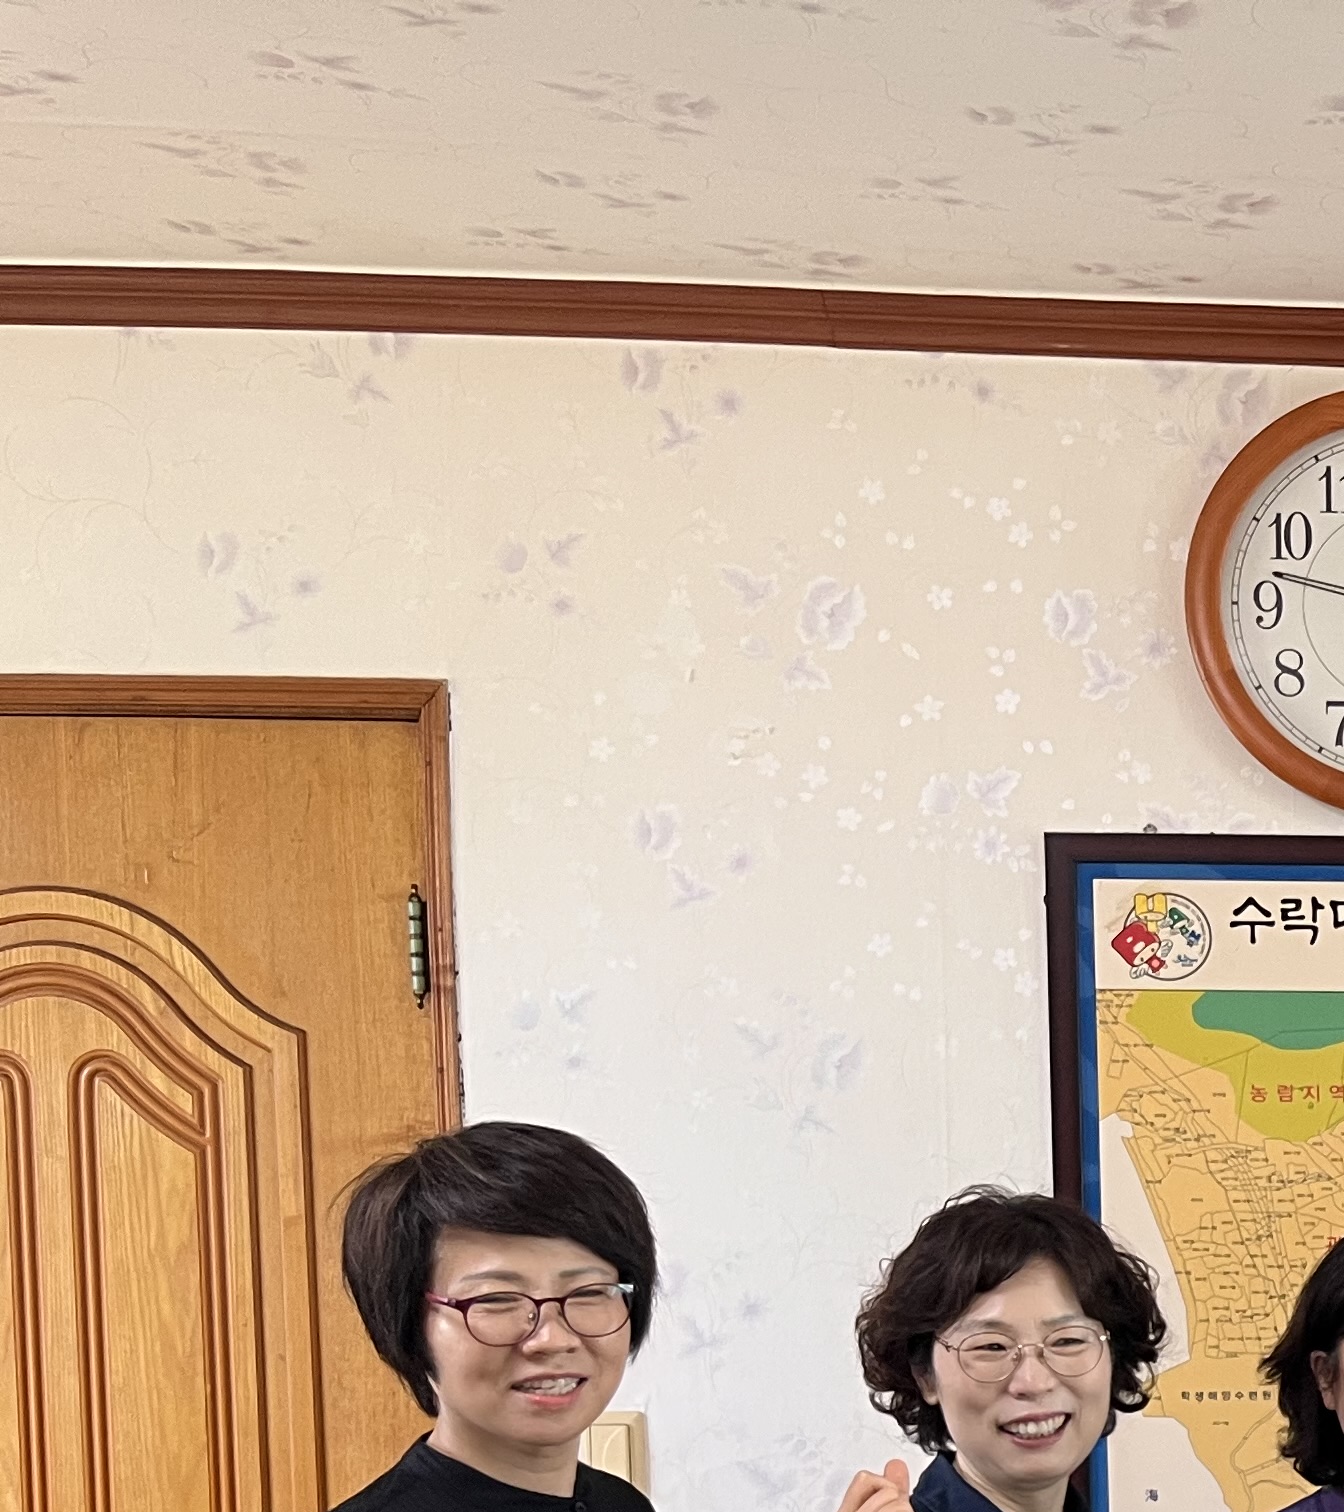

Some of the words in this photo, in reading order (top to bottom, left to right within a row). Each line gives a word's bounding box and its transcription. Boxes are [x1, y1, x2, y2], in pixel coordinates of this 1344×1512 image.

[1268, 511, 1312, 561] 10
[1253, 580, 1284, 629] 9
[1273, 648, 1305, 697] 8
